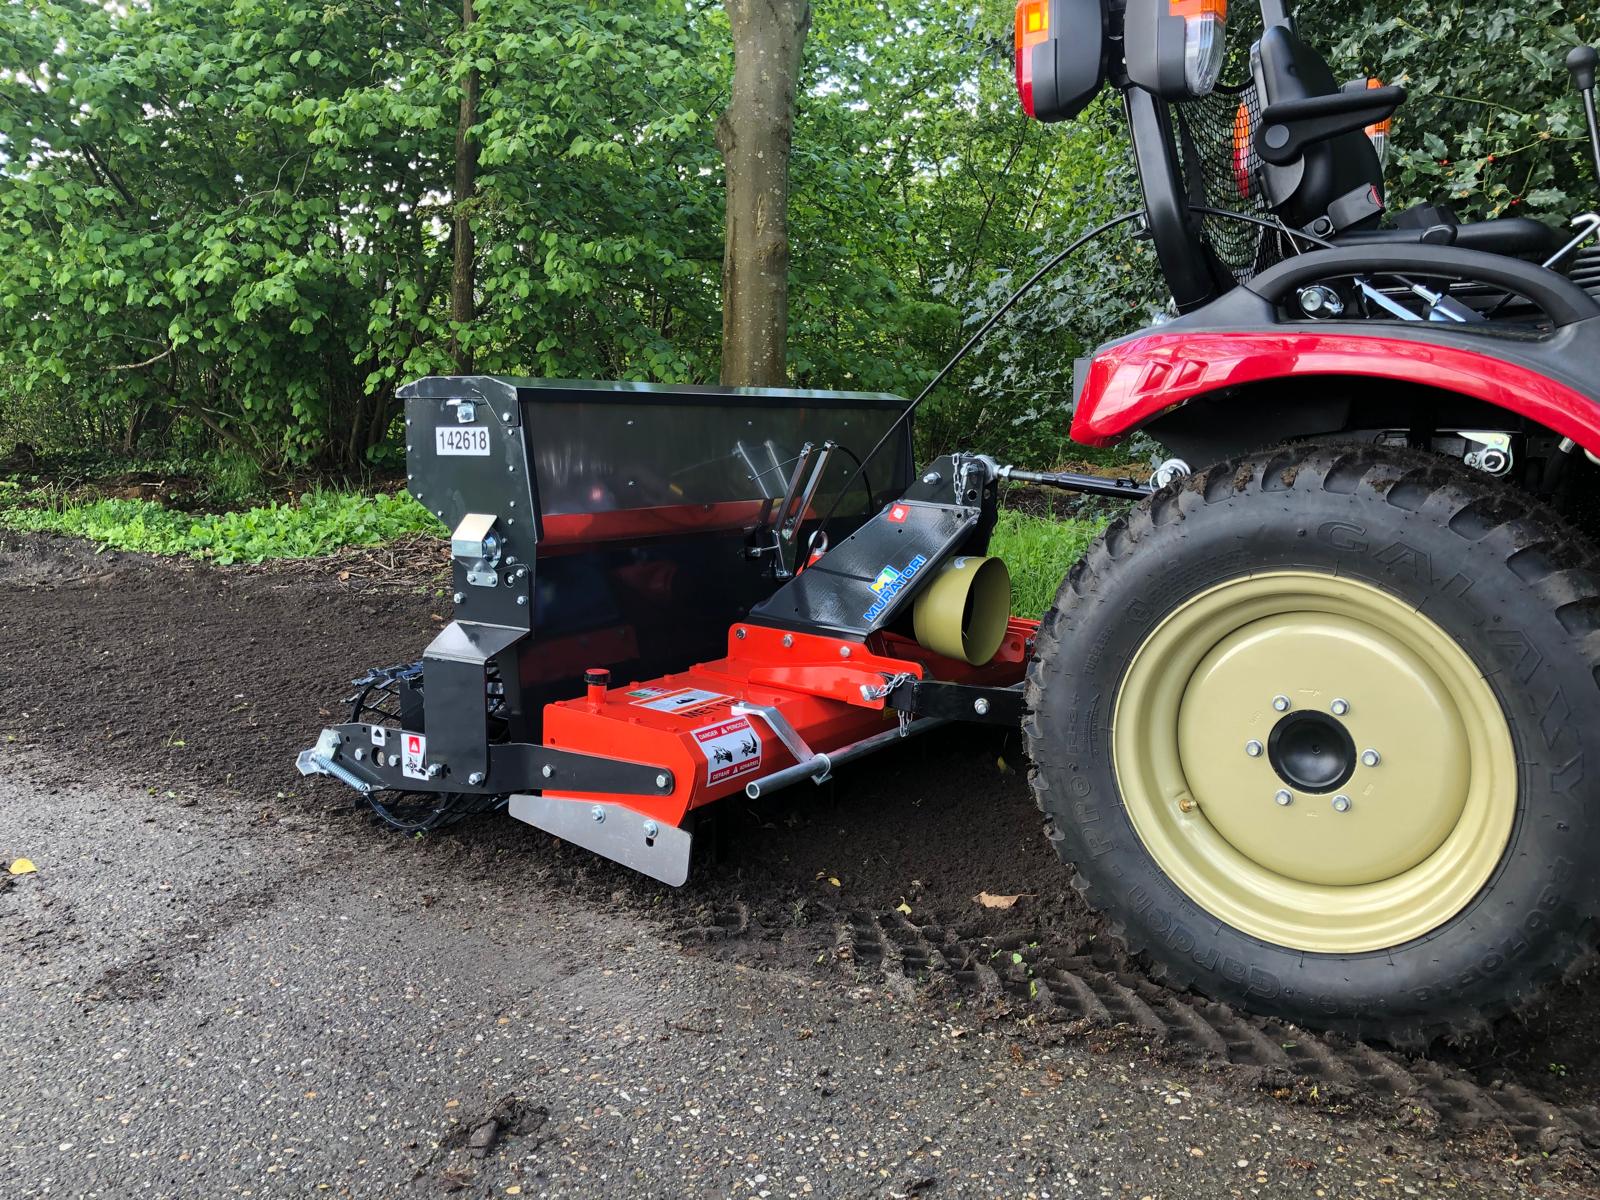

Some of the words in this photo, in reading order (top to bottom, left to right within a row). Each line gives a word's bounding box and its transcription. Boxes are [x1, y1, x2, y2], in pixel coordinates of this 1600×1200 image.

[439, 430, 487, 450] 142618
[863, 554, 927, 622] MURATORI
[1317, 520, 1582, 808] GALAXY
[698, 730, 719, 740] DANGER
[1129, 884, 1282, 1000] Garden
